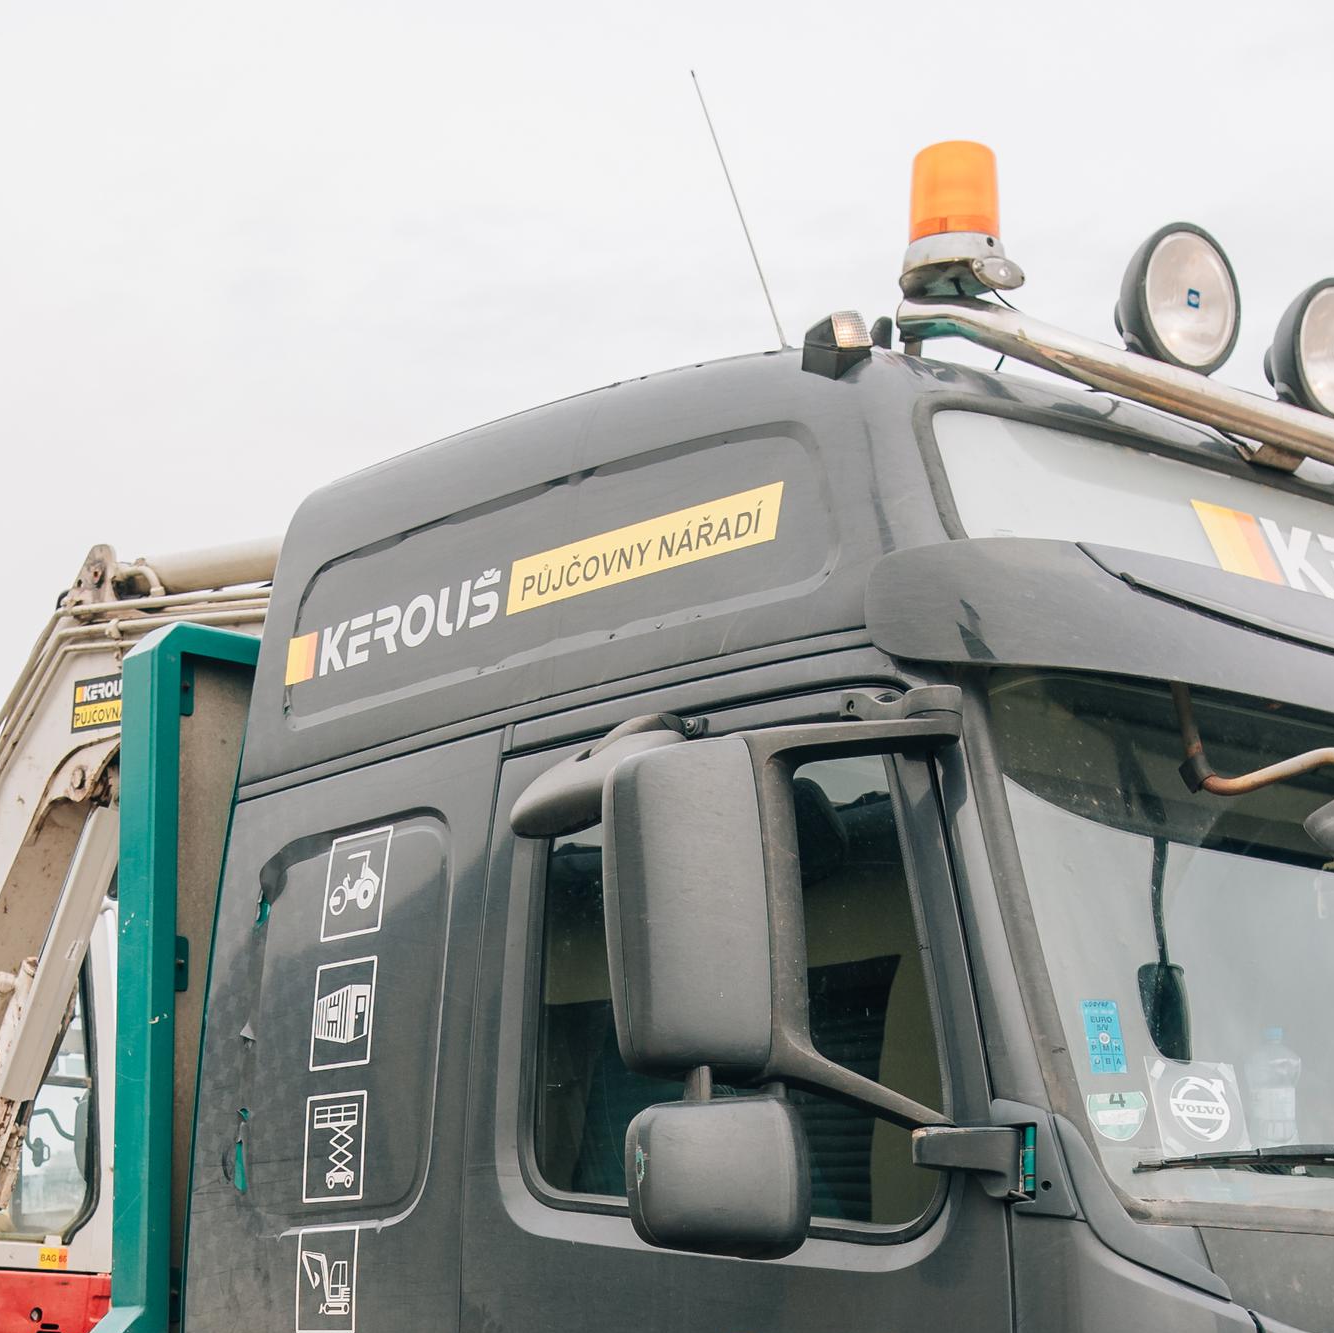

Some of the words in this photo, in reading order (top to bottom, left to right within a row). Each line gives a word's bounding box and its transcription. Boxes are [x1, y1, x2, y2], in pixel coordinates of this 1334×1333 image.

[319, 568, 501, 676] KEROUŠ
[520, 540, 653, 602] PŮJČOVNY
[657, 501, 764, 560] NÁŘADÍ
[82, 679, 123, 702] KEROU
[74, 704, 122, 726] PŮJČOVN
[1174, 1103, 1226, 1116] VOLVO
